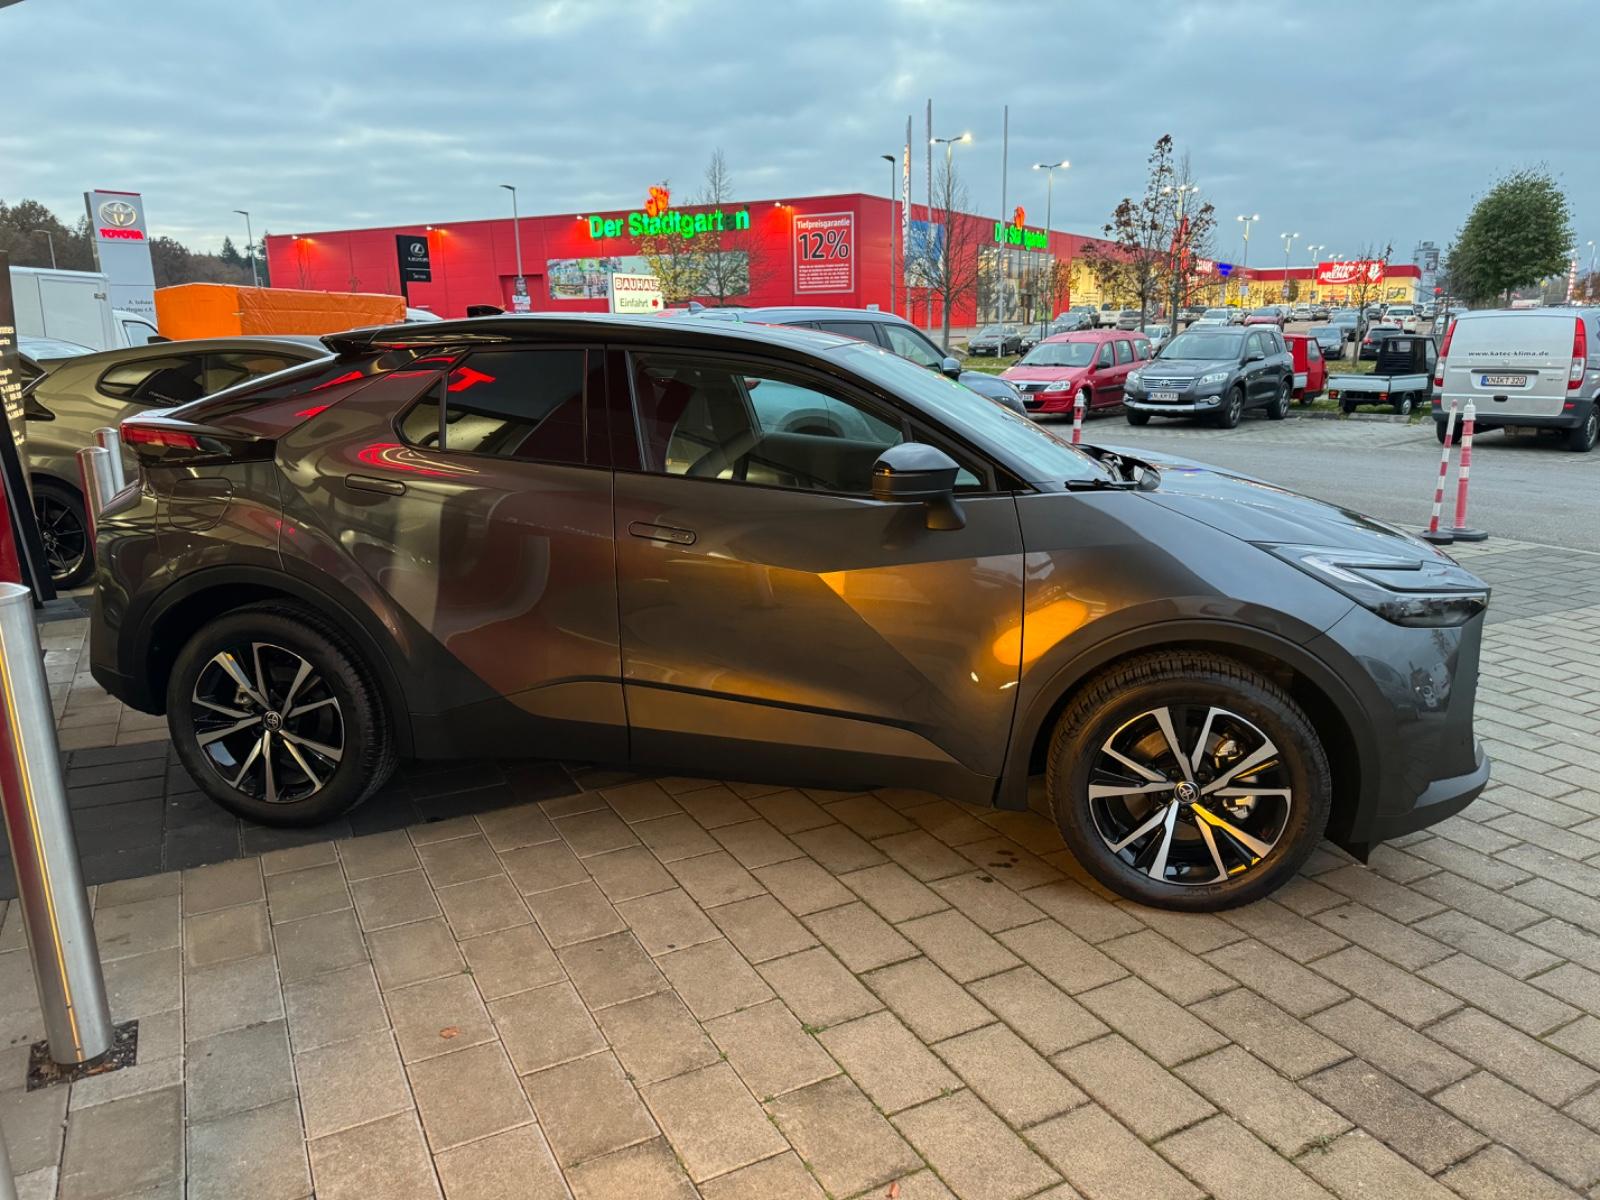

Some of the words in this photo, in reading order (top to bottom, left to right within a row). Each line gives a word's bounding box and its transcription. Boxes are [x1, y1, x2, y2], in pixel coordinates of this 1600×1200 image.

[589, 215, 624, 238] Der
[628, 209, 749, 239] Stadtgarten
[797, 218, 850, 230] Tiefpreisgarantie
[100, 228, 144, 240] TOYOTA
[799, 230, 849, 260] 12%
[1320, 271, 1349, 279] ARENA
[620, 298, 649, 307] Einfahrt
